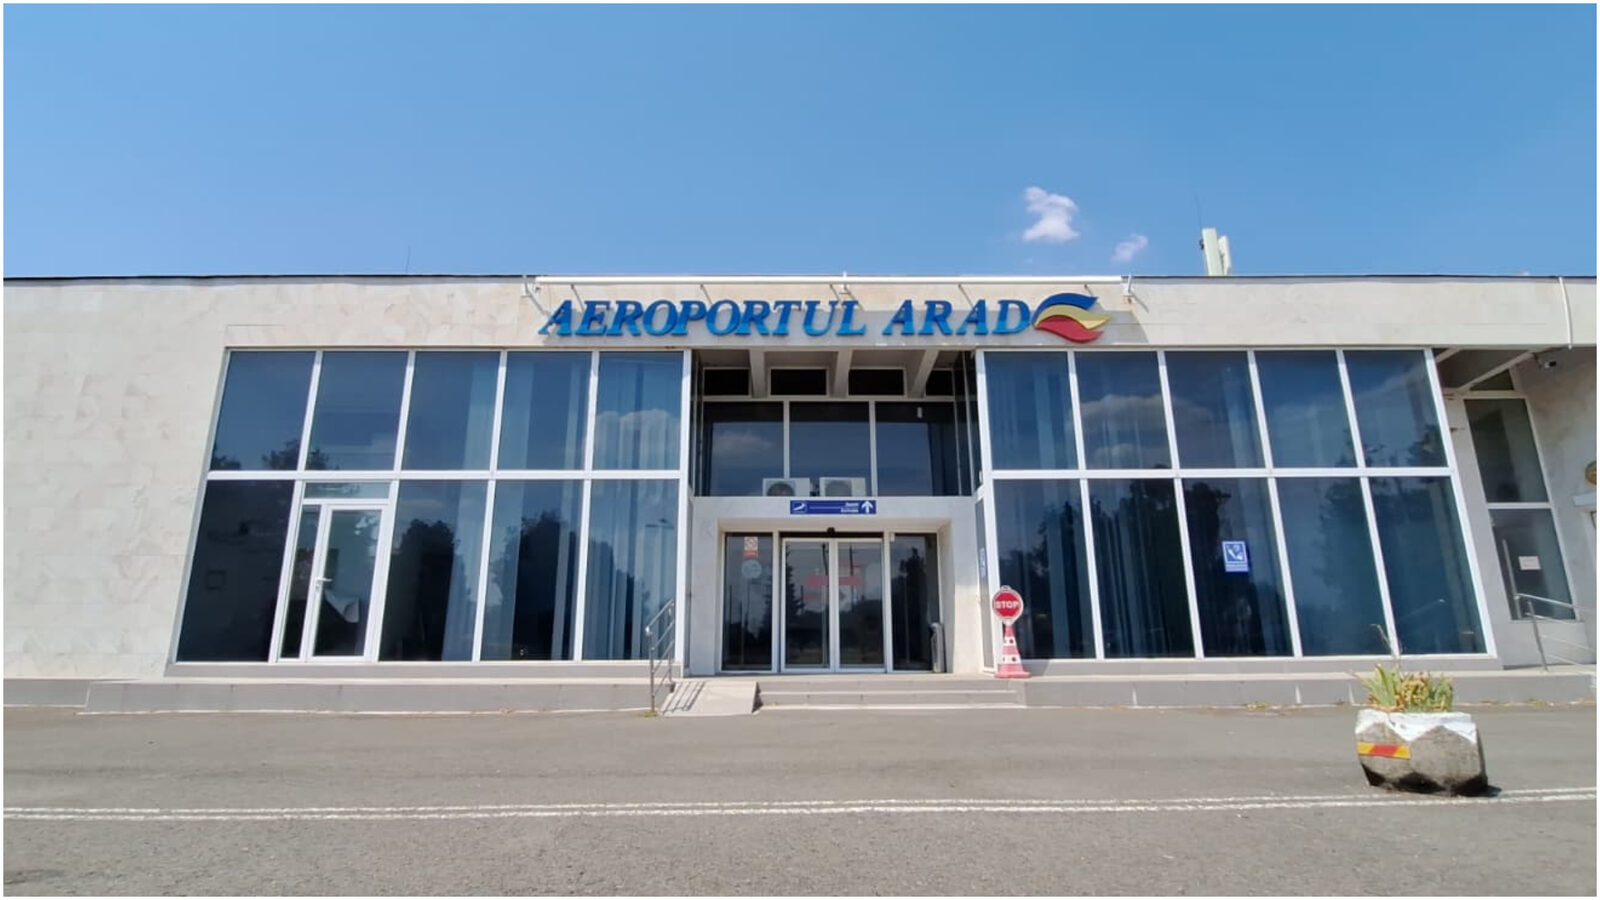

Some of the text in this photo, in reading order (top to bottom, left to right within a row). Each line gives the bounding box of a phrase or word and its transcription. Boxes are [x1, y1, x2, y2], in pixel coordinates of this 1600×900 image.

[538, 299, 1031, 337] AEROPORTUL ARAD
[995, 600, 1019, 609] STOP
